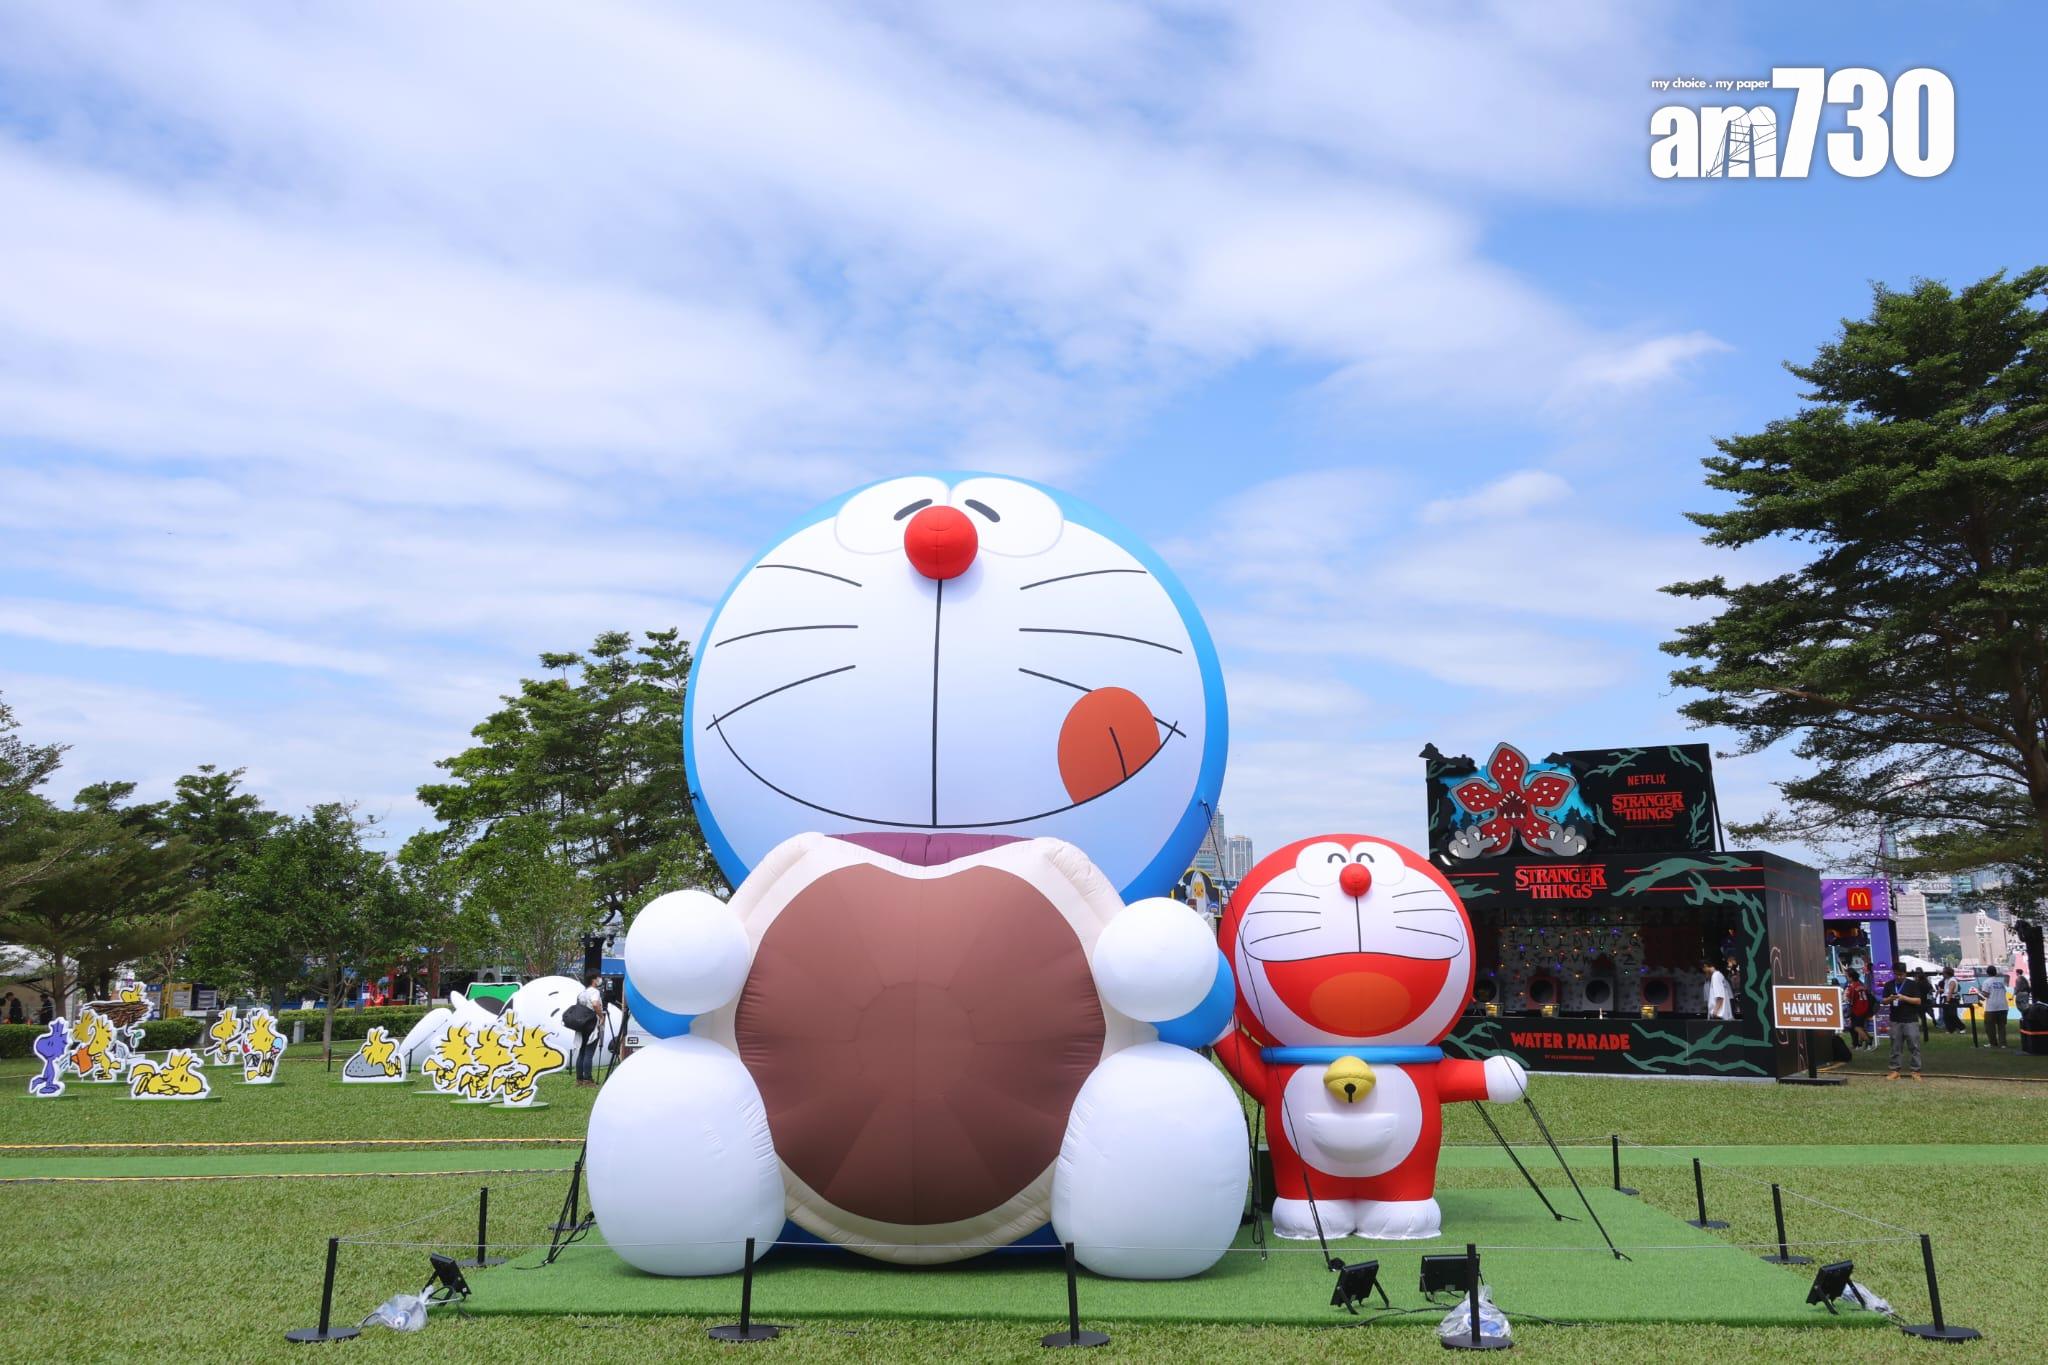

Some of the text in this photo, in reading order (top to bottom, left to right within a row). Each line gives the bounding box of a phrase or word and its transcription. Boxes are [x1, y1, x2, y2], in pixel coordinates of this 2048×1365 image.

[1627, 774, 1667, 786] NETFLIX
[1612, 793, 1685, 811] STRANGER
[1624, 807, 1674, 820] THINGS
[1515, 867, 1608, 888] STRANGER
[1529, 883, 1593, 899] THINGS
[1793, 993, 1821, 1001] LEAVING
[1782, 1002, 1834, 1016] HAWKINS
[1510, 1032, 1630, 1050] WATER PARADE
